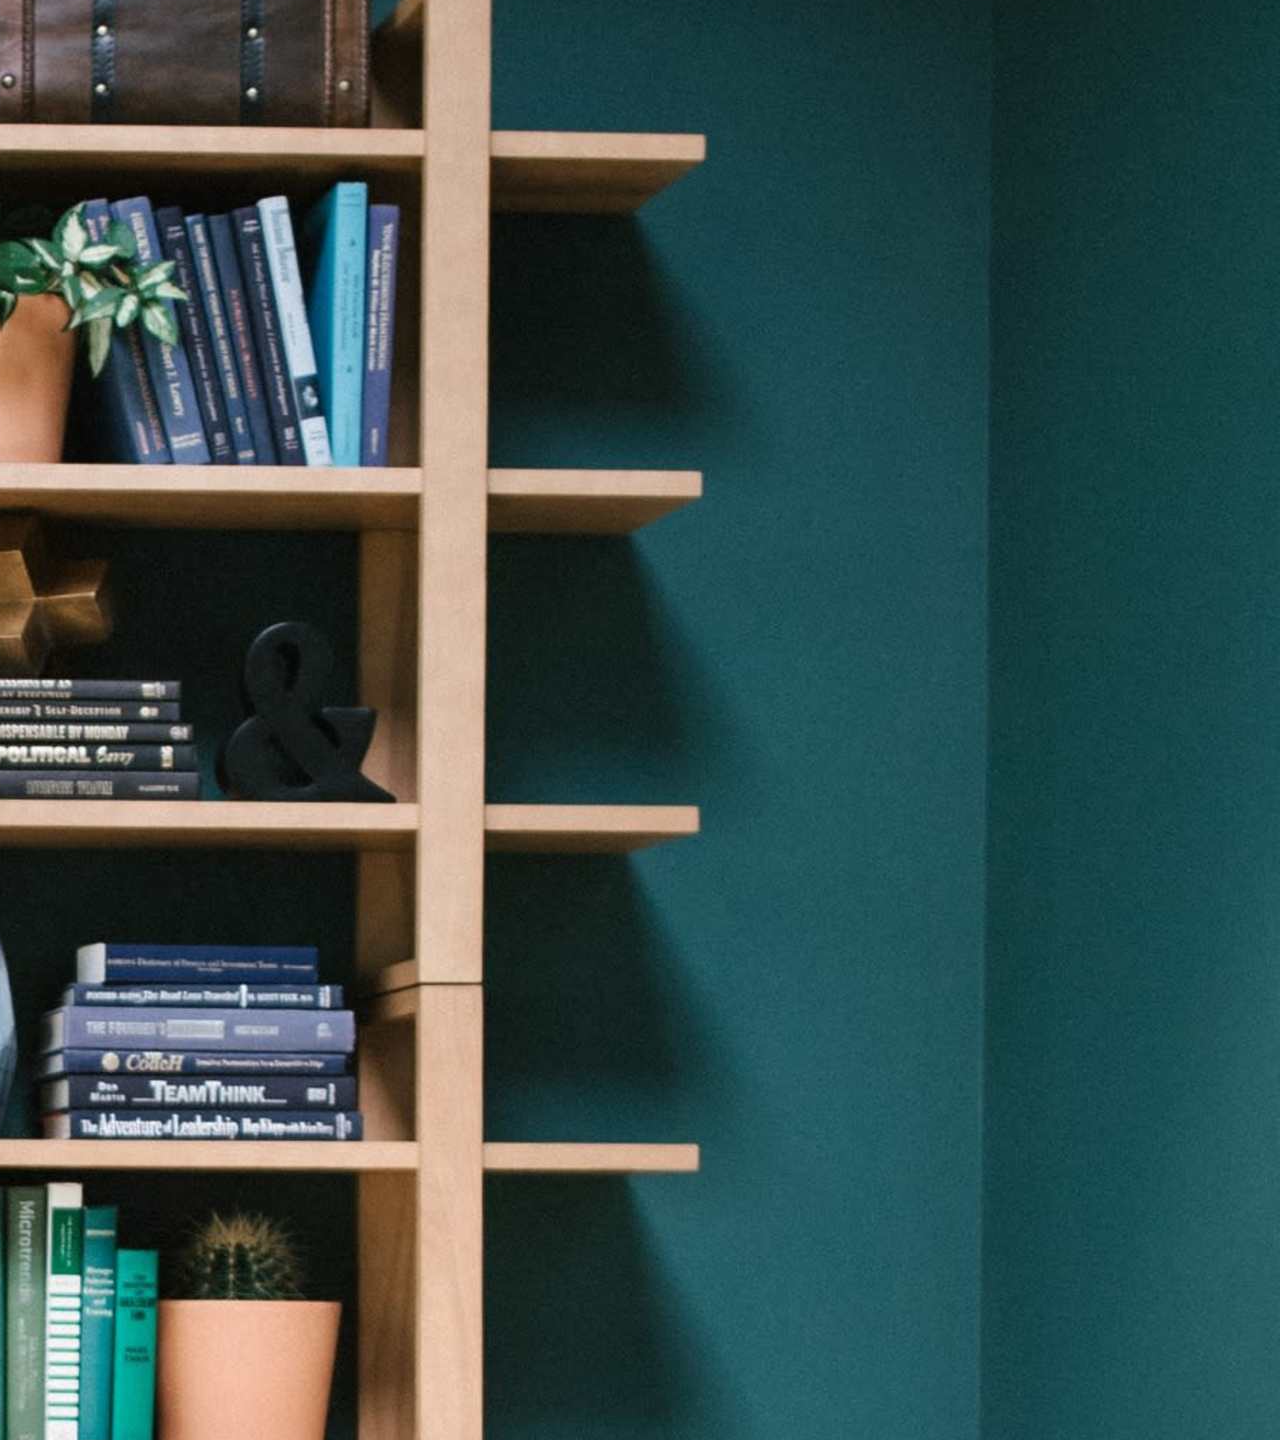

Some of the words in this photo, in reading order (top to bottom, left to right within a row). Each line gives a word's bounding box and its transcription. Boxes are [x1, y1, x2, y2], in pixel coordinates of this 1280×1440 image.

[380, 223, 394, 252] YOUR
[167, 383, 185, 417] Lowry
[45, 705, 121, 716] SELF-DECEPTION
[67, 725, 83, 739] BY
[84, 725, 130, 740] MONDAY
[143, 991, 159, 1001] The
[159, 991, 181, 1001] Road
[182, 991, 202, 1001] Less
[81, 1119, 97, 1133] The
[98, 1114, 162, 1137] Adventure
[172, 1114, 239, 1140] Leadership
[18, 1200, 35, 1305] Microtrends
